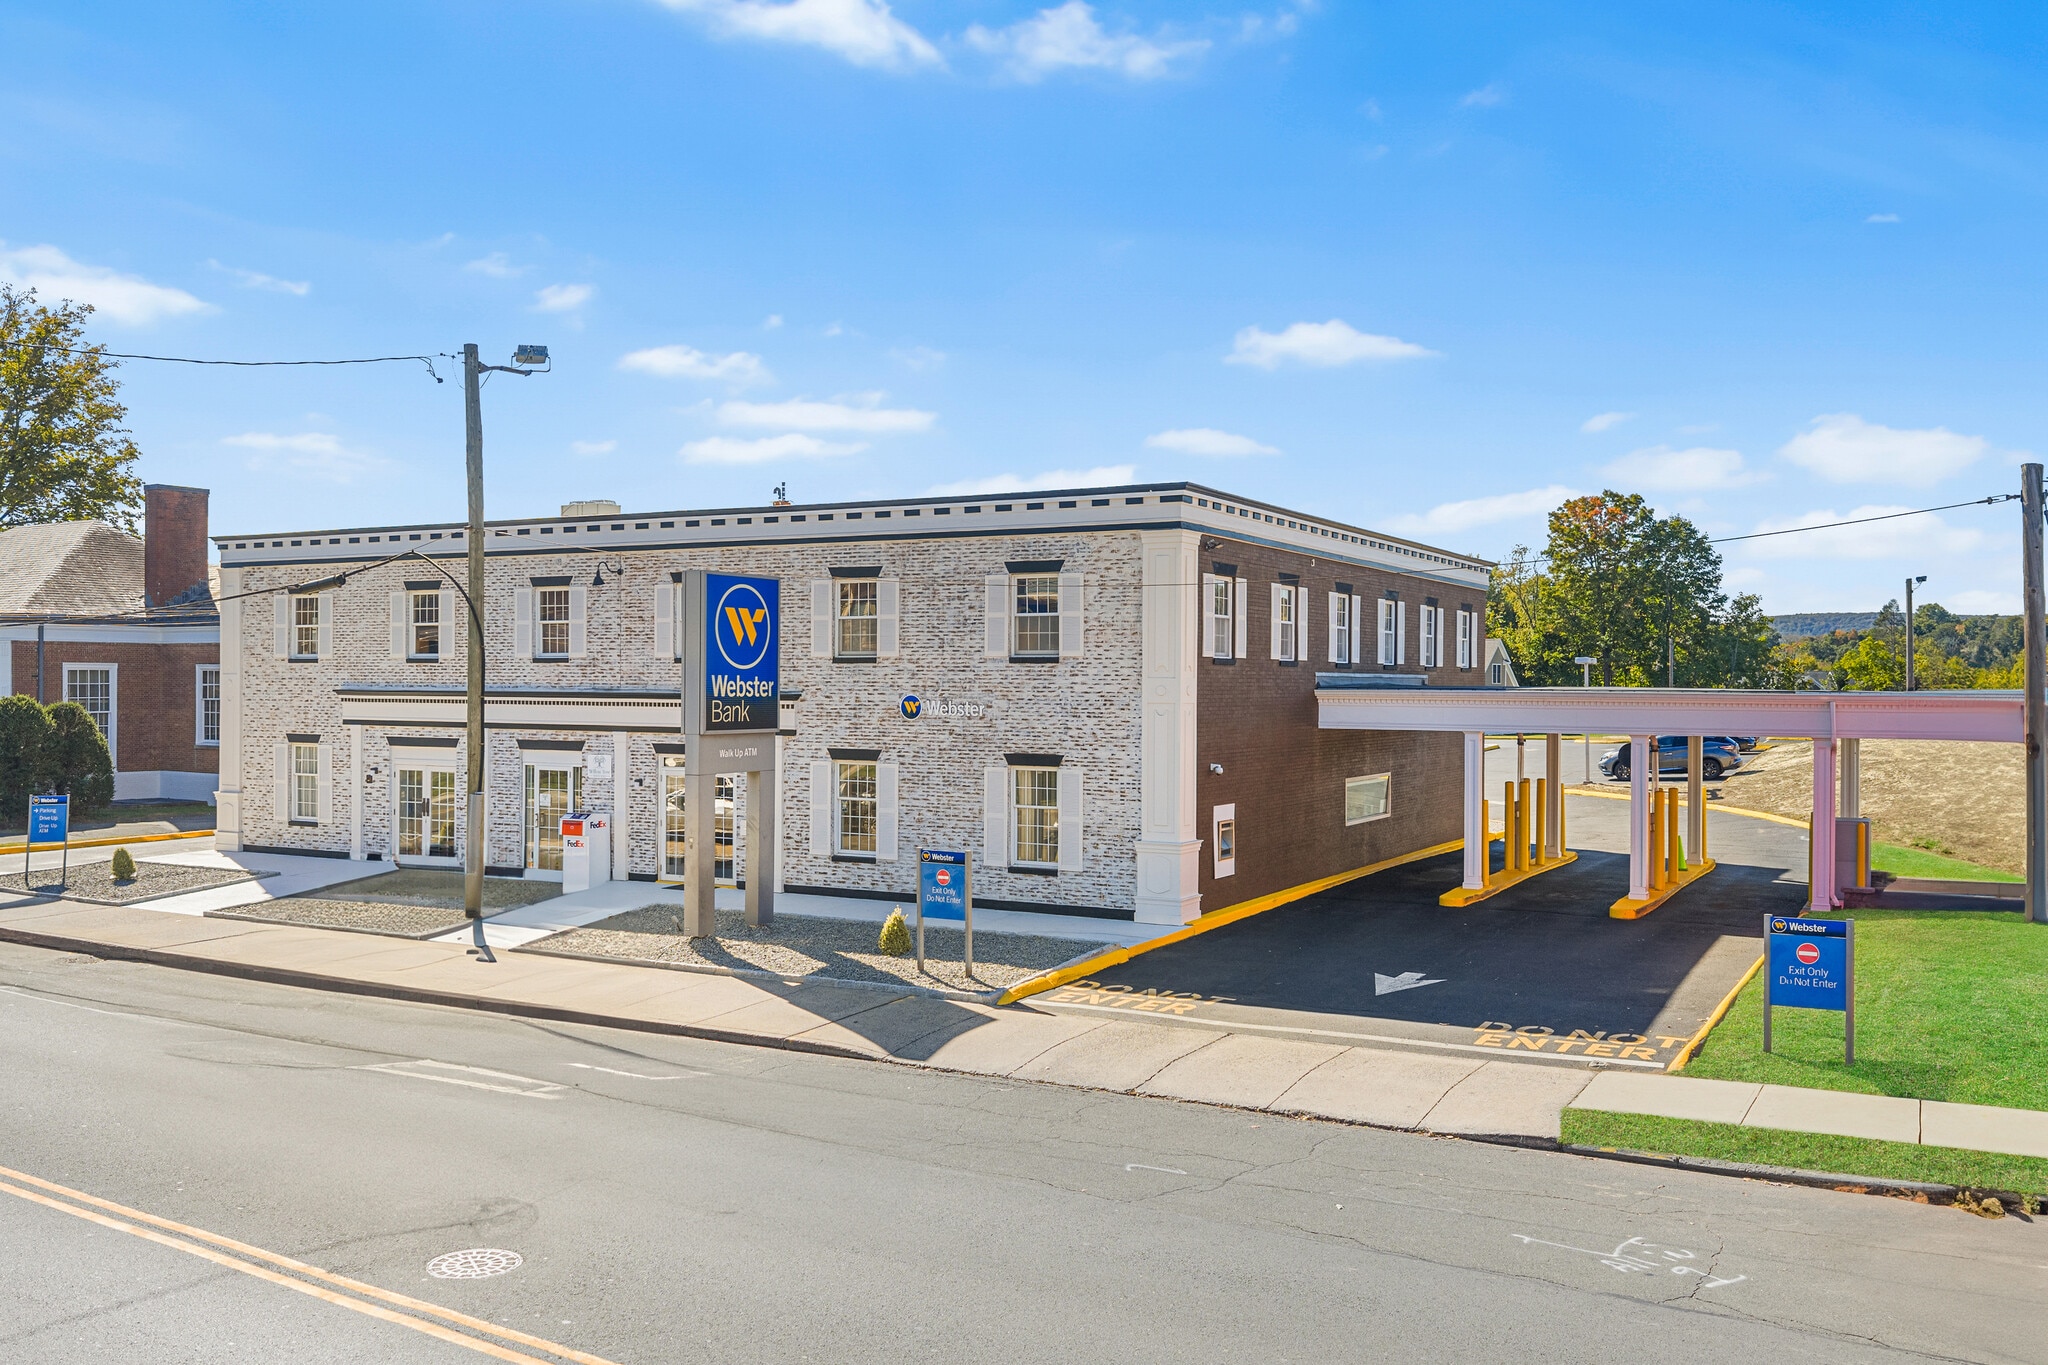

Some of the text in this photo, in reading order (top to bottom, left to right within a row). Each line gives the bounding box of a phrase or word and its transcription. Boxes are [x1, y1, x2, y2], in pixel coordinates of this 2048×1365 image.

[711, 675, 774, 697] Webster
[711, 700, 750, 723] Bank
[927, 700, 984, 716] Webster
[719, 748, 757, 758] Walk Up ATM
[590, 821, 606, 829] FedEx
[567, 839, 584, 848] FedEx
[932, 853, 954, 861] Webster
[943, 888, 956, 896] Only
[1789, 922, 1826, 932] Webster
[1789, 965, 1828, 978] Exit Only
[1794, 977, 1810, 987] Not
[1813, 979, 1837, 988] Enter
[1047, 992, 1198, 1015] ENTER
[1474, 1020, 1690, 1049] DO NOT
[1473, 1033, 1657, 1061] ENTER
